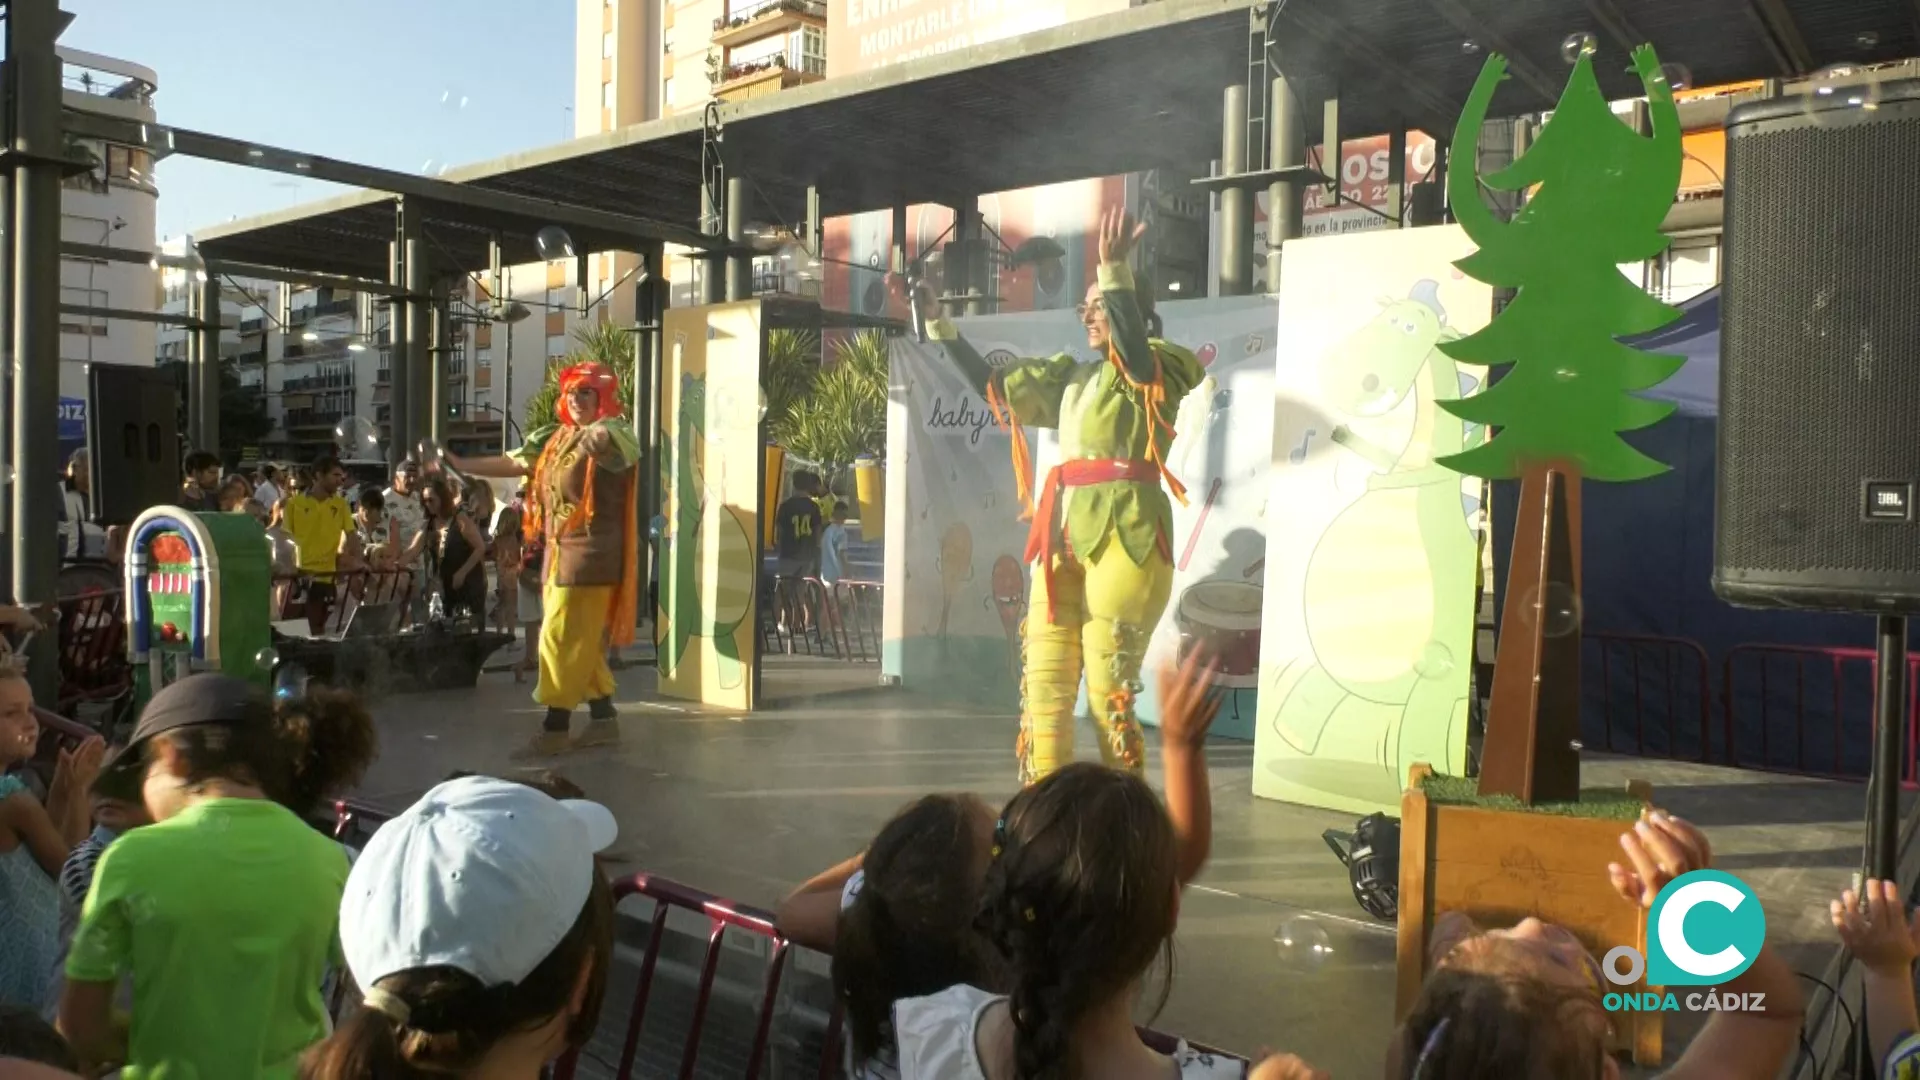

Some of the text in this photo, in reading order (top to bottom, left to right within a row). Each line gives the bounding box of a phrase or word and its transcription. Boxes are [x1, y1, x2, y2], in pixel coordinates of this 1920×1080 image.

[860, 4, 964, 57] MONTARLE
[1315, 222, 1326, 234] en
[1330, 216, 1341, 232] la
[791, 514, 813, 540] 14
